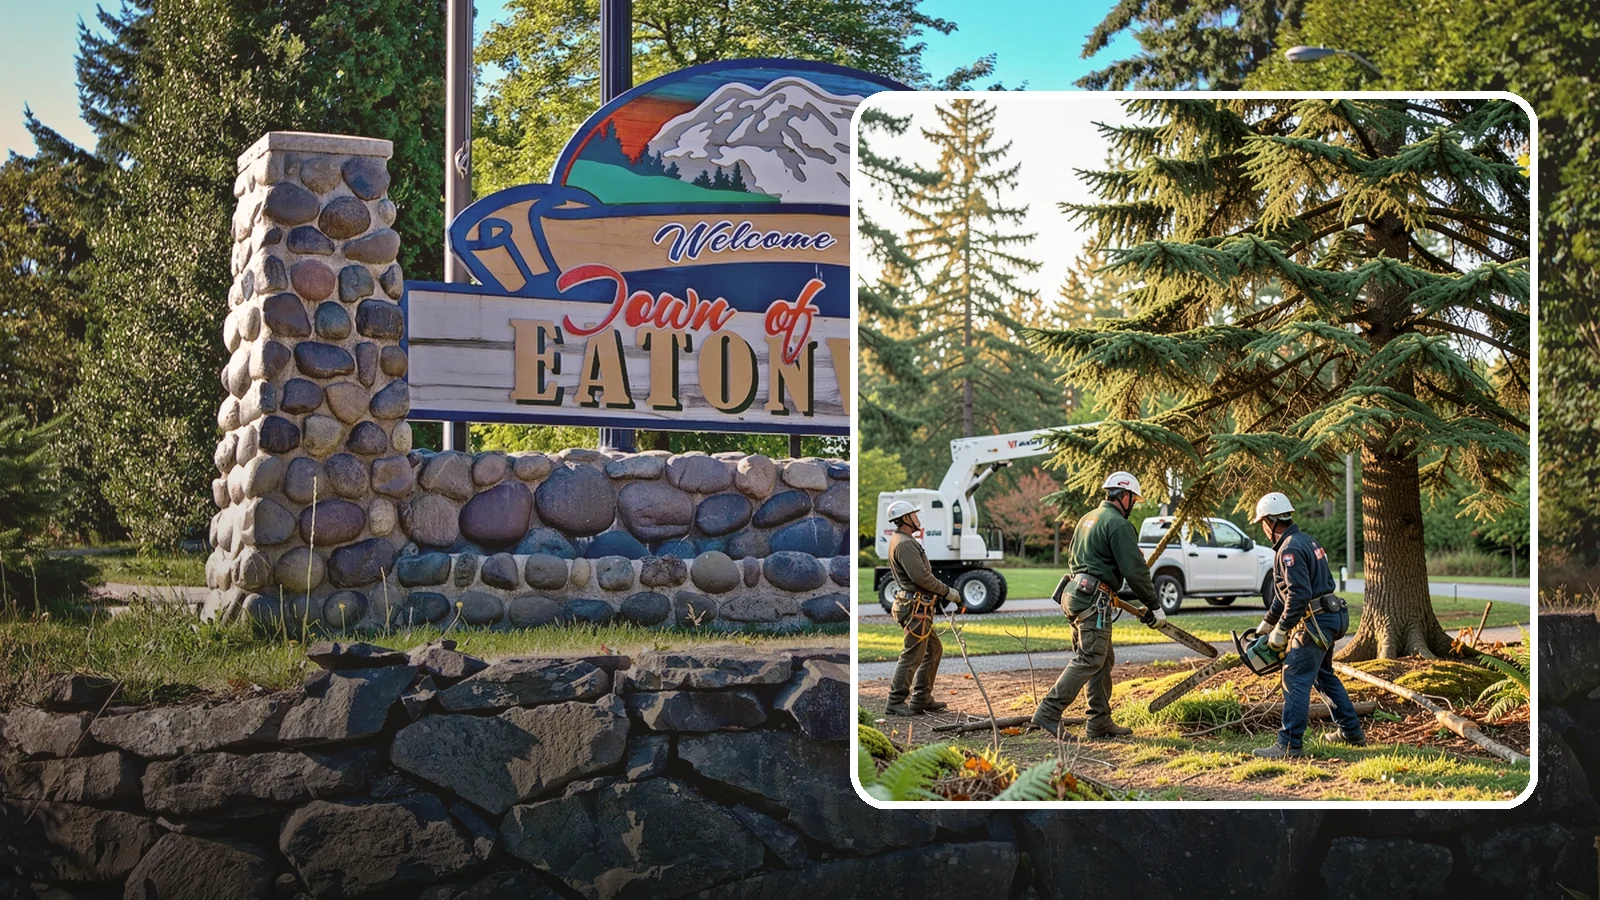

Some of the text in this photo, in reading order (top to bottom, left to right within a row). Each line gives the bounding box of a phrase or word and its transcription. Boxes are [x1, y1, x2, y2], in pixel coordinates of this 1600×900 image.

[654, 220, 837, 262] Welcome
[557, 264, 825, 365] Town of
